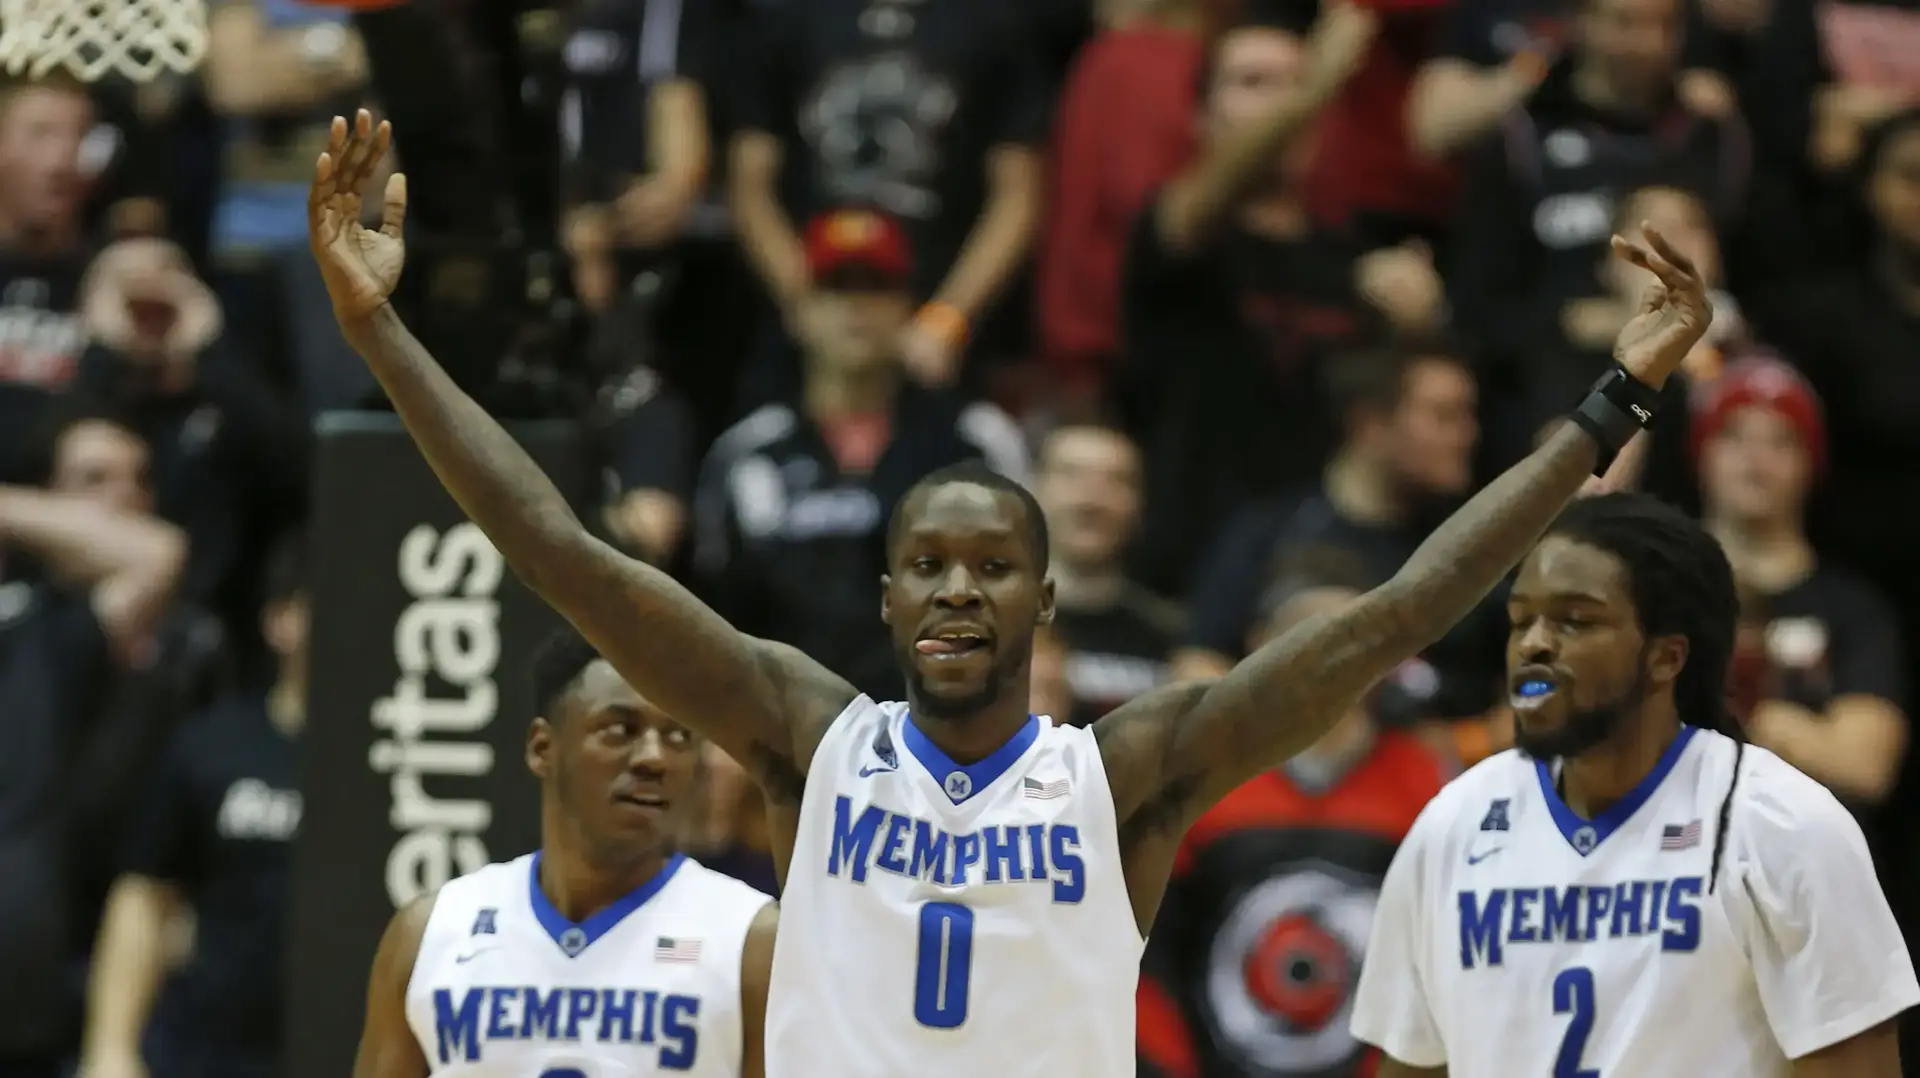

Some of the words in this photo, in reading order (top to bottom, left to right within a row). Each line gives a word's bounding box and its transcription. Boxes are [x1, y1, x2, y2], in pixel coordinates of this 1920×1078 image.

[826, 793, 1087, 905] MEMPHIS
[914, 901, 975, 1029] 0
[1457, 875, 1705, 970] MEMPHIS
[433, 985, 702, 1071] MEMPHIS
[1552, 965, 1601, 1078] 2
